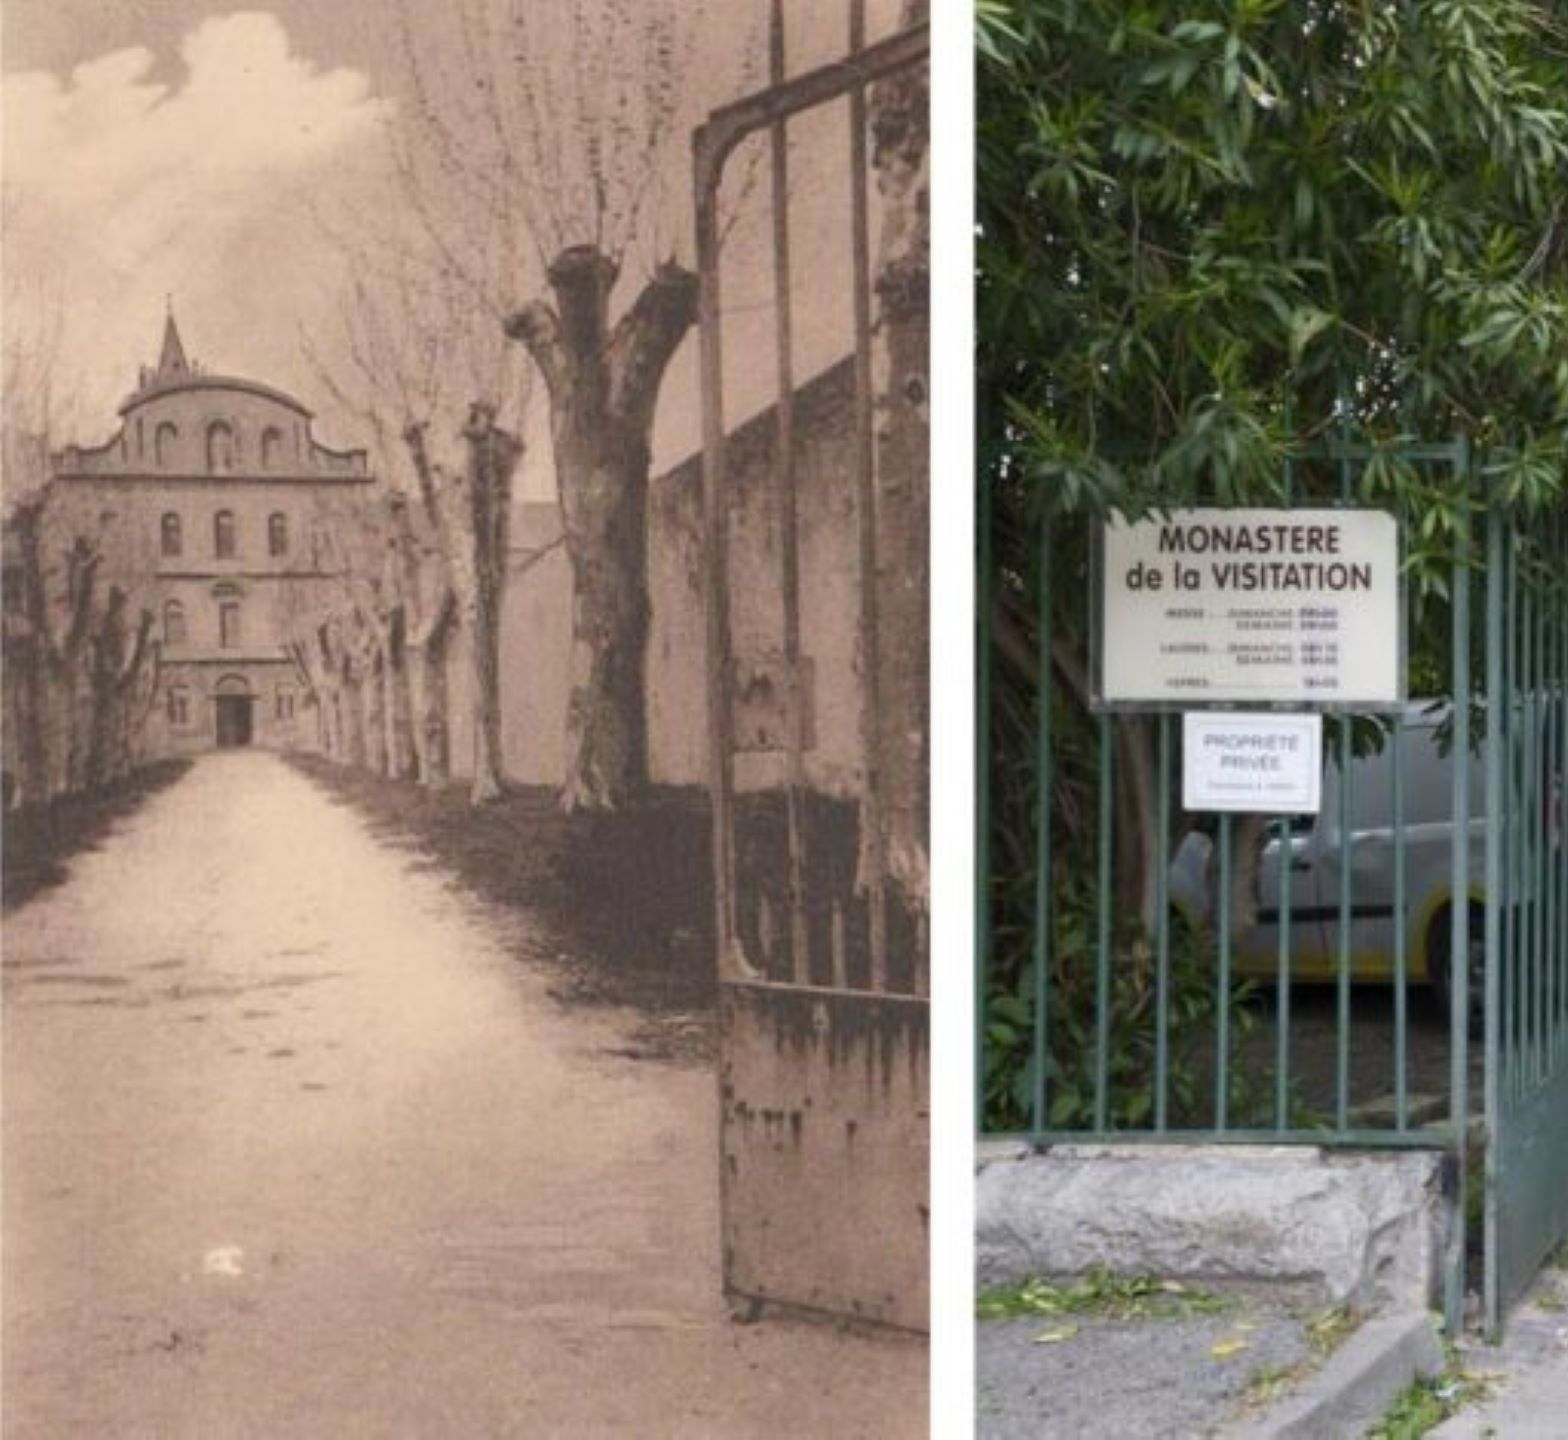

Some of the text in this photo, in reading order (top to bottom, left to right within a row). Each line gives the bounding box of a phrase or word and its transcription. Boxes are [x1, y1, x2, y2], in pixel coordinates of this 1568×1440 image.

[1158, 525, 1341, 553] MONASTERE
[1126, 562, 1372, 590] de la VISITATION
